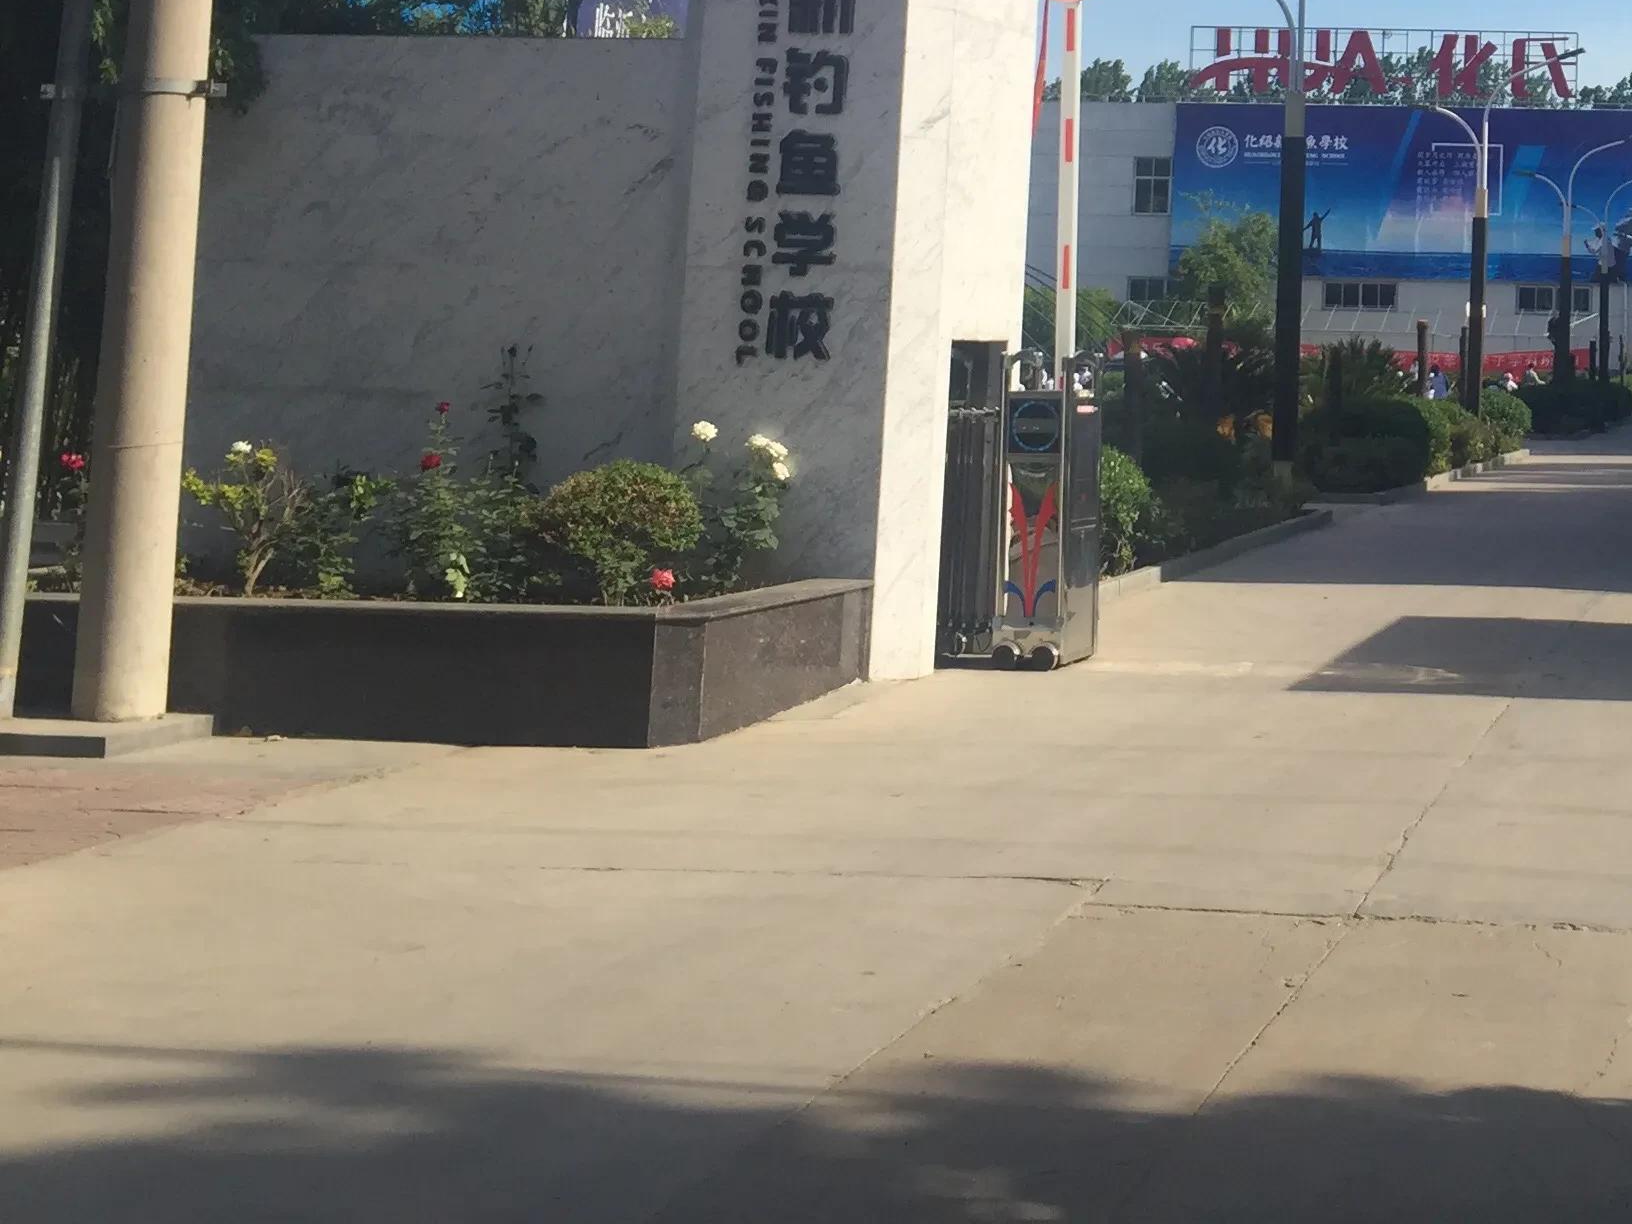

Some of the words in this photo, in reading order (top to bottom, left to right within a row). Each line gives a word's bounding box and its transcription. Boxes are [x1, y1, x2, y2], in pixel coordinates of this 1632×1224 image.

[747, 56, 779, 203] FISHING
[1431, 32, 1577, 99] 化氏
[735, 216, 767, 365] SCHOOL
